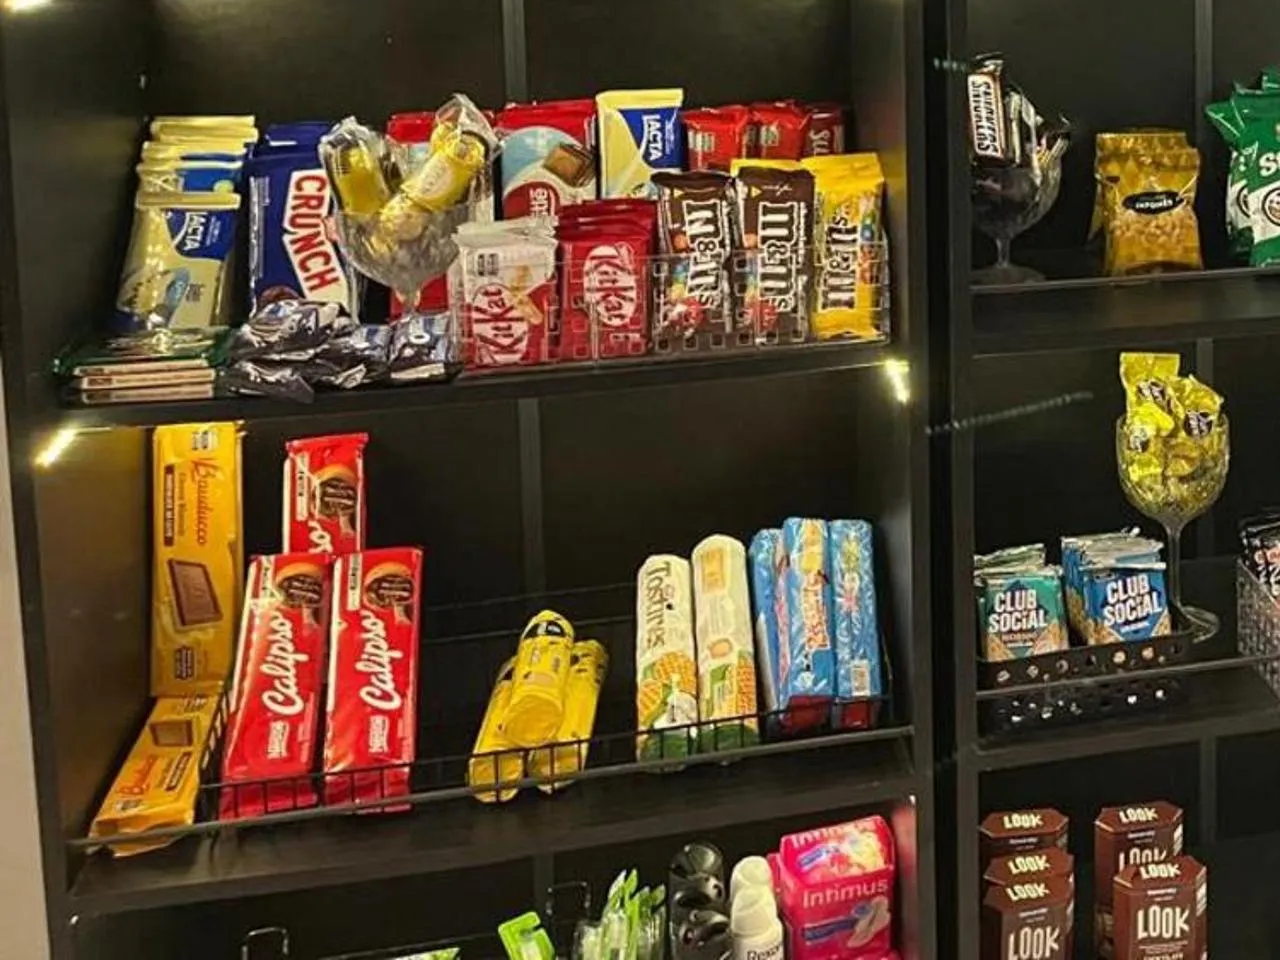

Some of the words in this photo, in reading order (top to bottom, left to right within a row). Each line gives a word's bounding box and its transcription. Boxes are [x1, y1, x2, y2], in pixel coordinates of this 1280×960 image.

[641, 114, 663, 161] LACTA
[289, 174, 340, 293] CRUNCH
[191, 458, 217, 546] Bauducco
[994, 588, 1038, 613] CLUB
[1106, 575, 1150, 603] CLUB
[263, 609, 310, 717] Calipso
[355, 609, 404, 714] Calipso
[1003, 813, 1044, 829] LOOK
[1119, 807, 1160, 824] LOOK
[1008, 854, 1050, 875] LOOK
[1139, 863, 1182, 880] LOOK
[803, 878, 888, 909] Intimus
[1006, 883, 1050, 902] LOOK
[1137, 904, 1190, 940] LOOK
[1008, 925, 1061, 960] LOOK
